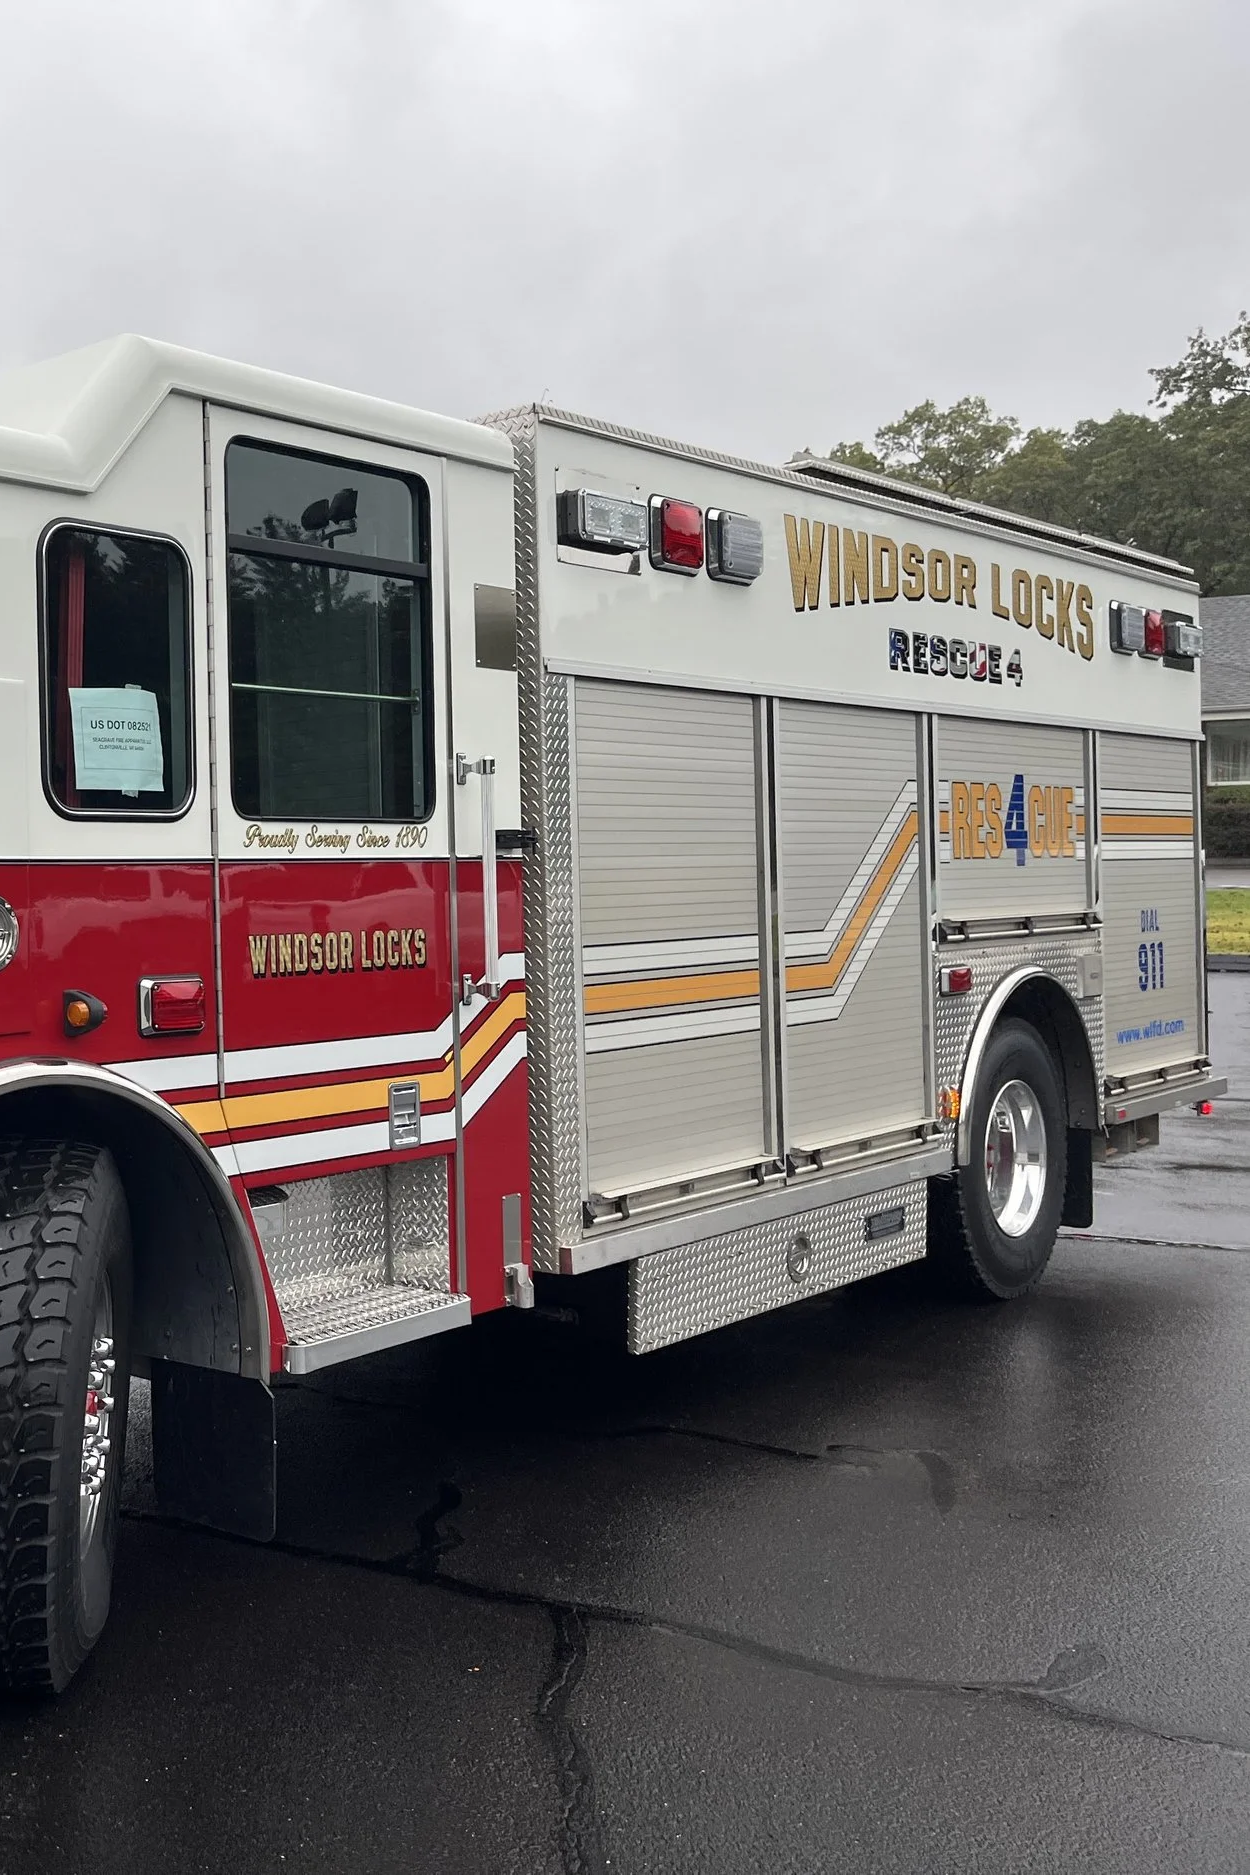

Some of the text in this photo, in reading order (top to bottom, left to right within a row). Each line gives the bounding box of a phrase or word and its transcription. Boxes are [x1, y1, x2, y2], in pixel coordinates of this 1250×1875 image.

[783, 513, 1095, 662] WINDSOR LOCKS
[888, 627, 1024, 688] RESCUE 4
[90, 720, 105, 730] US
[107, 720, 126, 730] DOT
[243, 823, 428, 854] Proudly Serving Since 1890
[1140, 909, 1160, 933] DIAL
[248, 928, 427, 979] WINDSOR LOCKS
[1138, 941, 1165, 992] 911
[1116, 1018, 1185, 1045] www.wlfd.com
